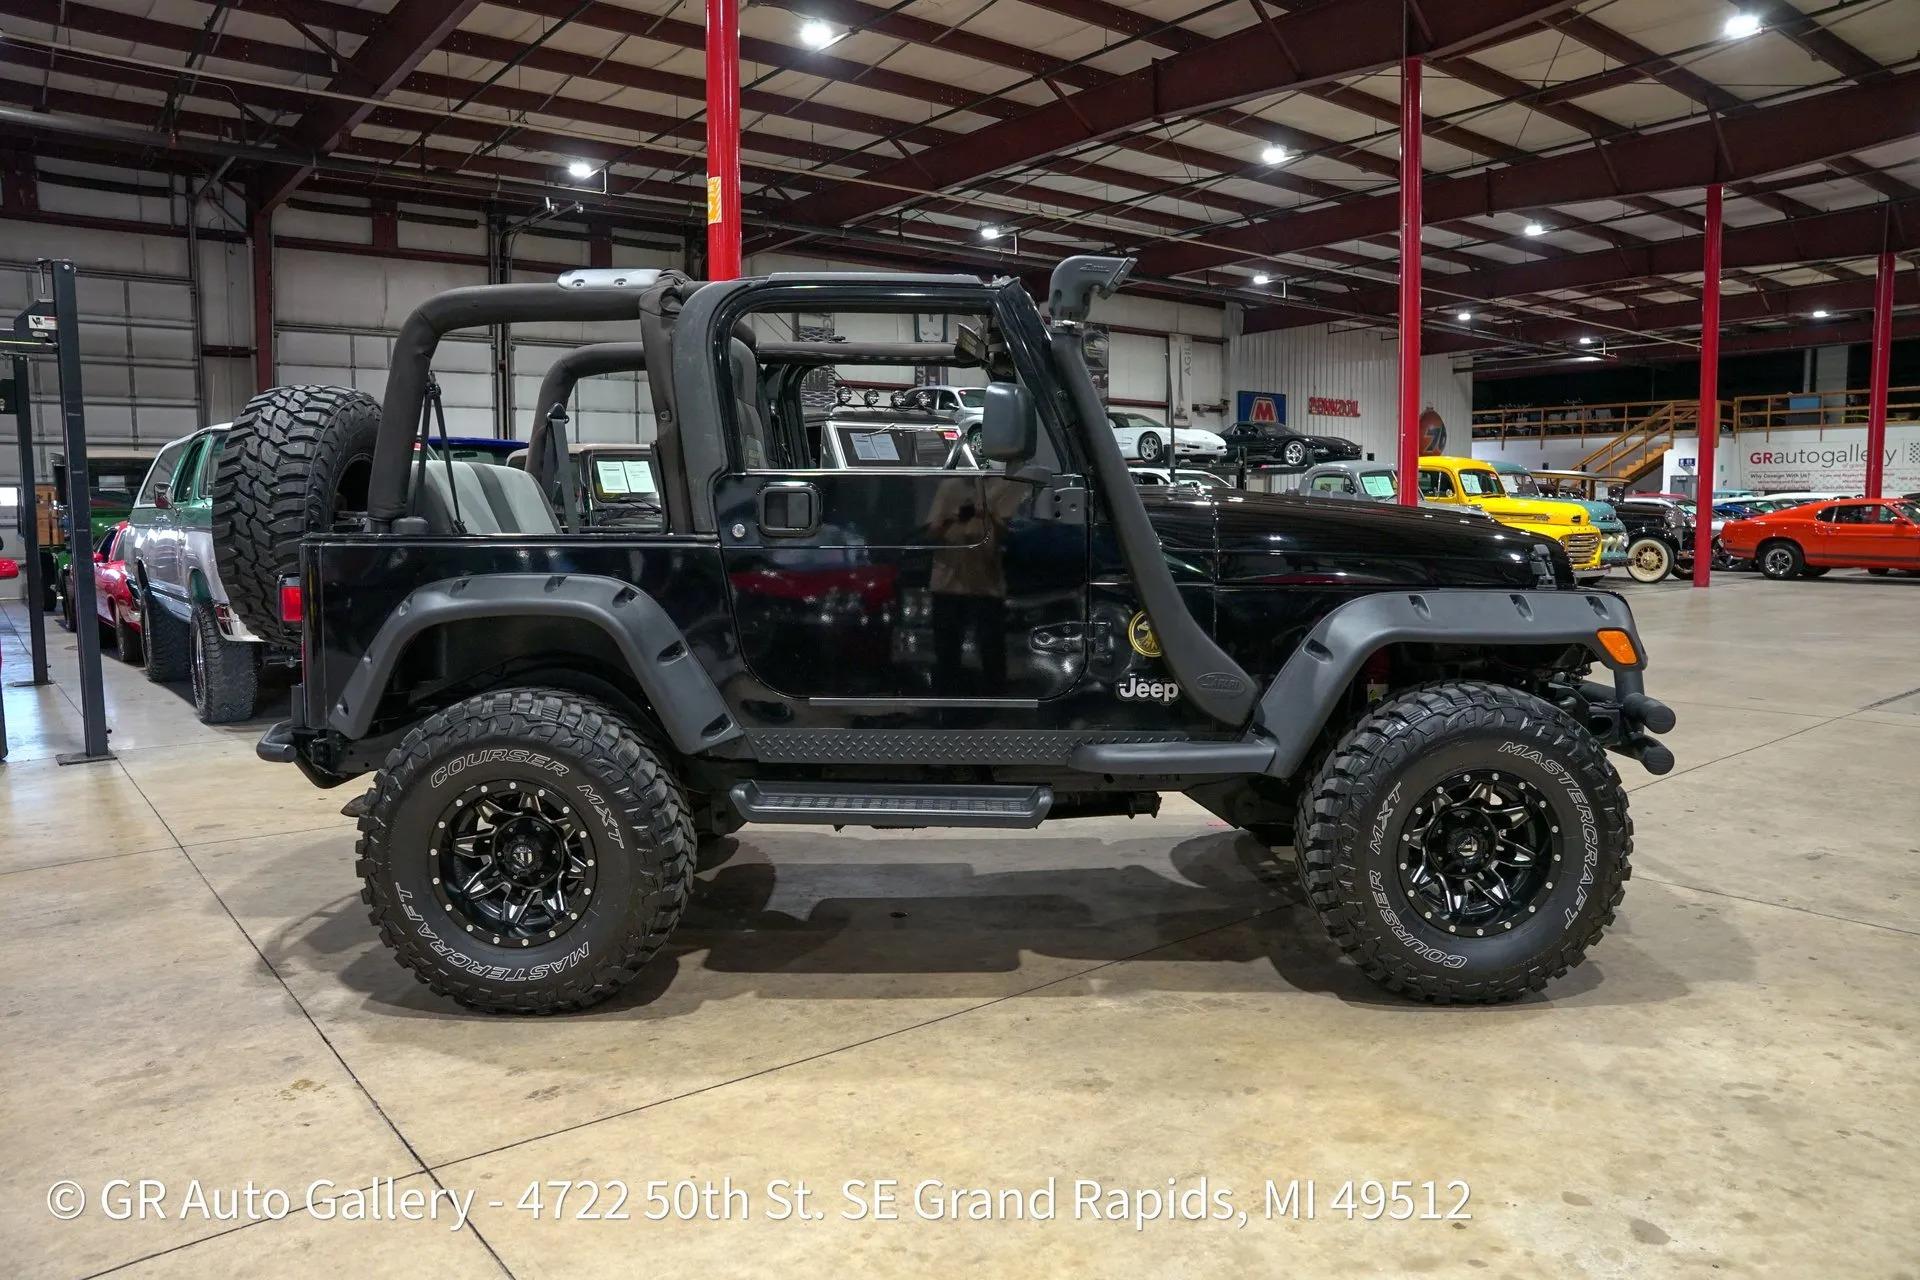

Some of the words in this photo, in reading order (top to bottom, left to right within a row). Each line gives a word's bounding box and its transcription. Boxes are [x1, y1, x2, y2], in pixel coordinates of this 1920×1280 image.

[1750, 443, 1897, 468] GRautogalley
[1119, 675, 1179, 701] Jeep
[430, 748, 570, 789] COURSER
[577, 784, 625, 849] MXT
[1369, 781, 1402, 855] MXT
[1498, 741, 1599, 930] MASTERCRAFT
[395, 881, 589, 982] MASTERCRAFT
[1368, 869, 1468, 969] COURSER
